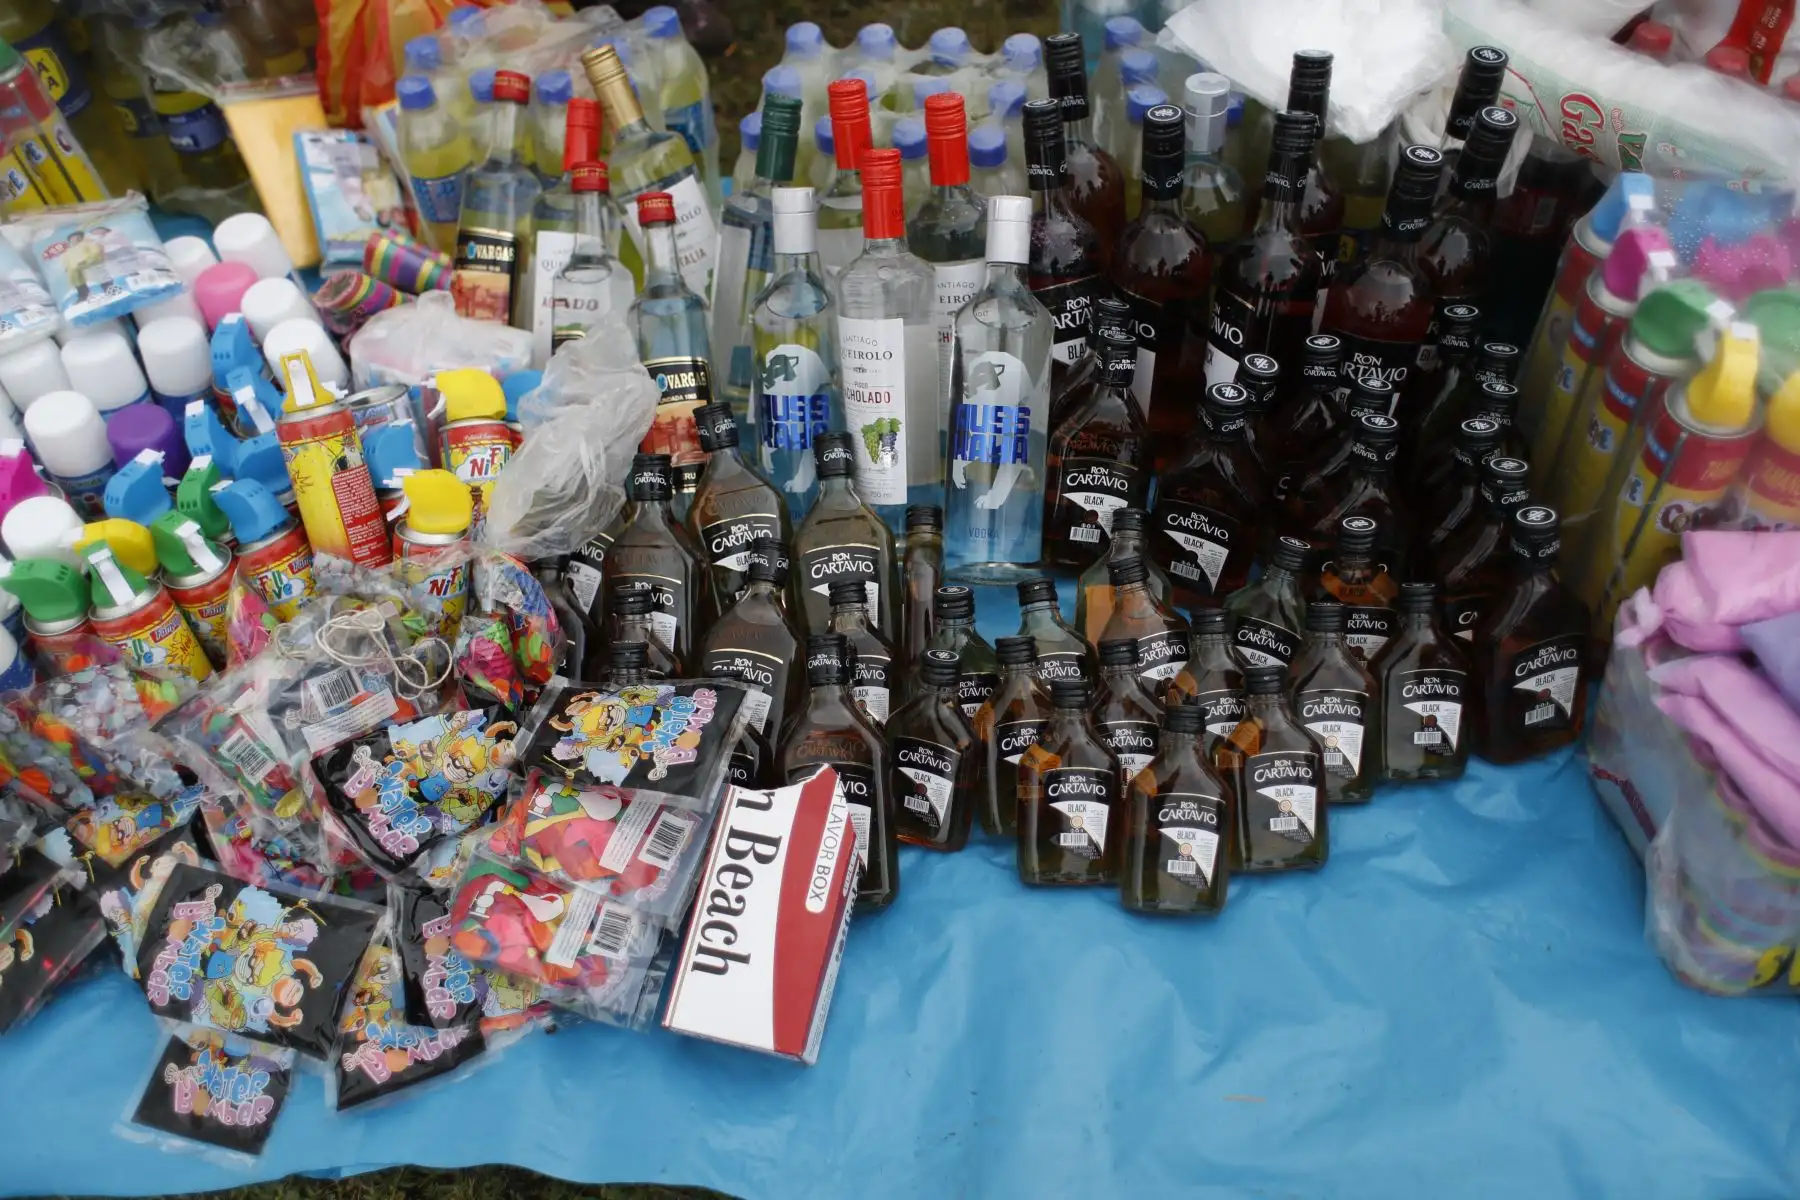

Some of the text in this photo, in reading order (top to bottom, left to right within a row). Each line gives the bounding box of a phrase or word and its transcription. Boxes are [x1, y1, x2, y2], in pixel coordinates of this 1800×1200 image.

[476, 244, 515, 262] VARGAS
[1066, 296, 1090, 311] RON
[1068, 343, 1086, 360] BLA
[1353, 353, 1382, 367] RON
[667, 372, 707, 390] VARGAS
[1090, 466, 1109, 475] RON
[634, 475, 667, 486] CARTAVIO
[1066, 473, 1128, 491] CARTAVIO
[1083, 495, 1105, 507] BLACK
[1190, 512, 1208, 522] RON
[731, 524, 748, 533] RON
[1167, 513, 1229, 541] CARTAVIO
[712, 529, 772, 554] CARTAVIO
[1183, 536, 1204, 549] BLACK
[832, 553, 850, 561] RON
[811, 560, 874, 579] CARTAVIO
[1259, 628, 1276, 639] RON
[1151, 640, 1166, 650] RON
[1237, 629, 1291, 657] CARTAVIO
[1538, 646, 1557, 656] RON
[734, 658, 752, 667] RON
[808, 657, 842, 669] CARTAVIO
[1249, 652, 1269, 665] BLACK
[1515, 648, 1577, 677] CARTAVIO
[1156, 668, 1175, 679] BLACK
[1534, 674, 1555, 687] BLACK
[1402, 684, 1459, 698] CARTAVIO
[1323, 696, 1340, 704] RON
[1303, 703, 1361, 718] CARTAVIO
[1421, 703, 1440, 713] BLACK
[1020, 728, 1037, 736] RON
[1115, 728, 1132, 736] RON
[1322, 724, 1342, 733] BLACK
[919, 746, 934, 756] RON
[898, 749, 952, 772] CARTAVIO
[1274, 759, 1291, 767] RON
[913, 771, 932, 783] BLACK
[1069, 775, 1086, 783] RON
[1254, 766, 1312, 782] CARTAVIO
[1048, 782, 1106, 796] CARTAVIO
[1274, 788, 1295, 797] BLACK
[1067, 803, 1087, 813] BLACK
[1180, 801, 1198, 809] RON
[1158, 807, 1217, 825] CARTAVIO
[1176, 830, 1196, 841] BLACK
[809, 793, 847, 903] FLAVOR BOX
[690, 825, 782, 976] Beach
